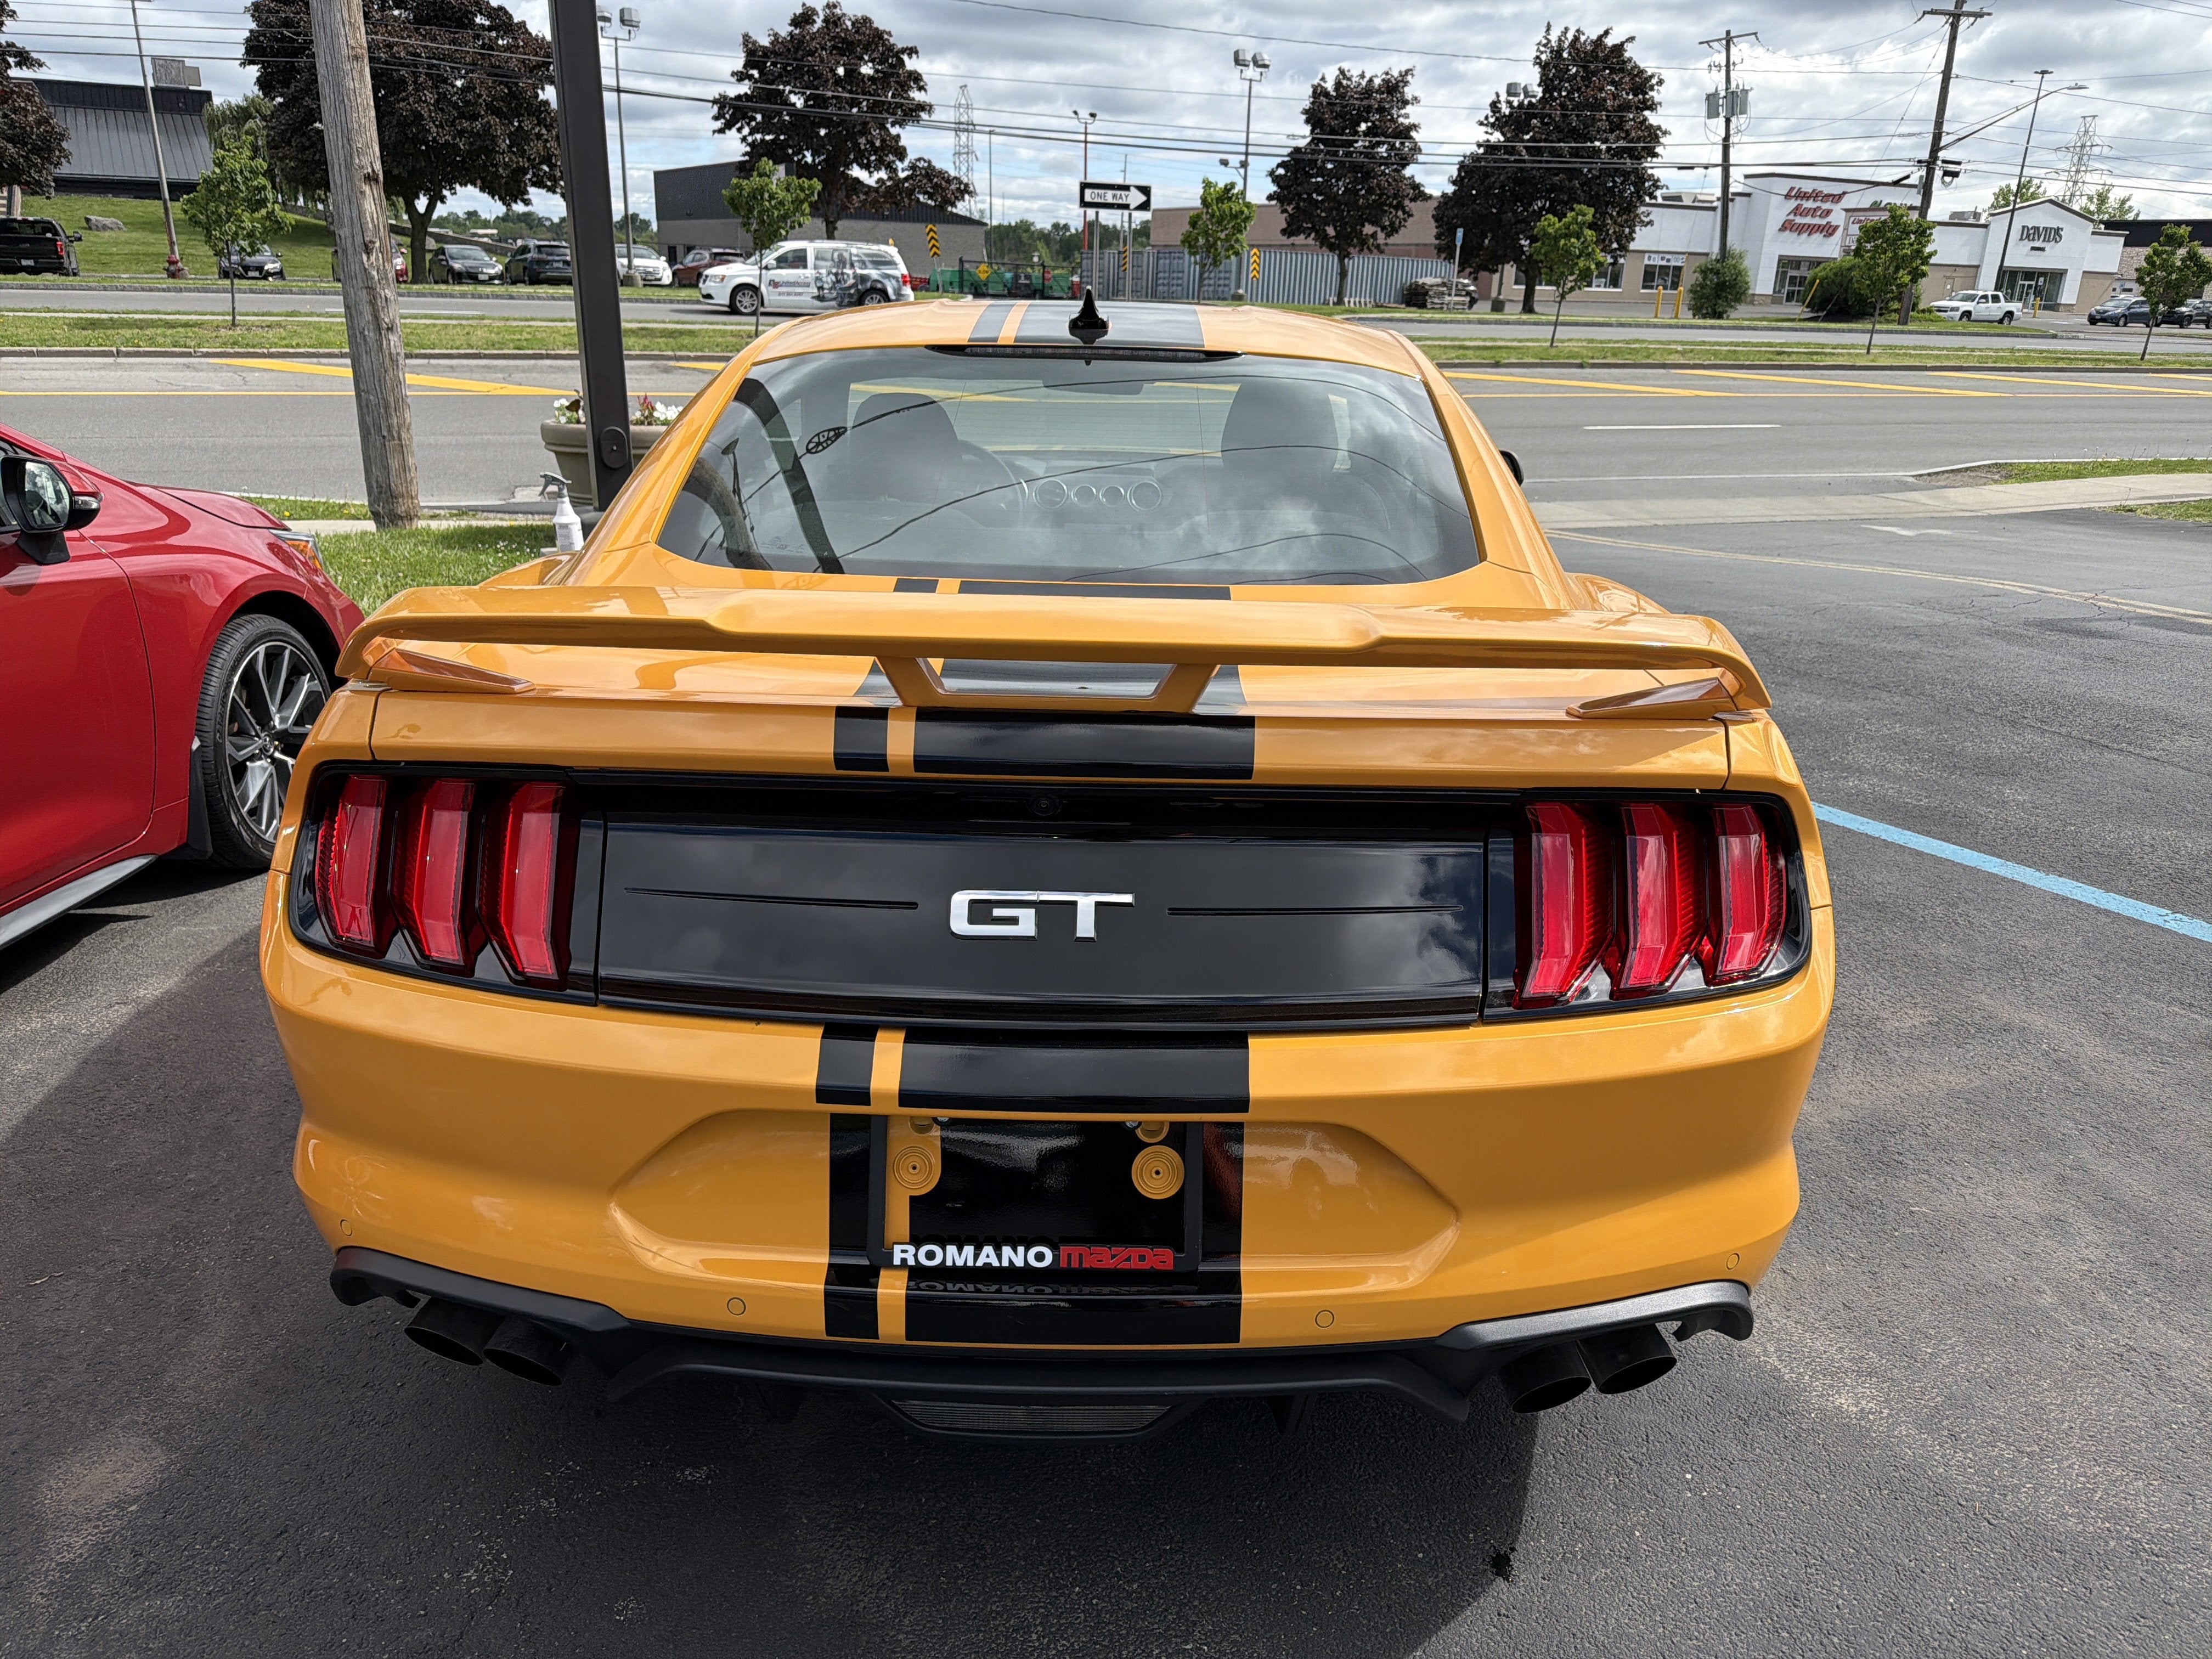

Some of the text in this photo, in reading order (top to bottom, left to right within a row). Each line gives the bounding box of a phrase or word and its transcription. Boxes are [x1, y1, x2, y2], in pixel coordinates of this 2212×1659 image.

[1090, 191, 1130, 202] ONE WAY
[1785, 187, 1848, 204] United
[1786, 204, 1833, 218] Auto
[1778, 219, 1841, 238] Supply
[950, 890, 1135, 942] GT
[893, 1244, 1053, 1268] ROMANO
